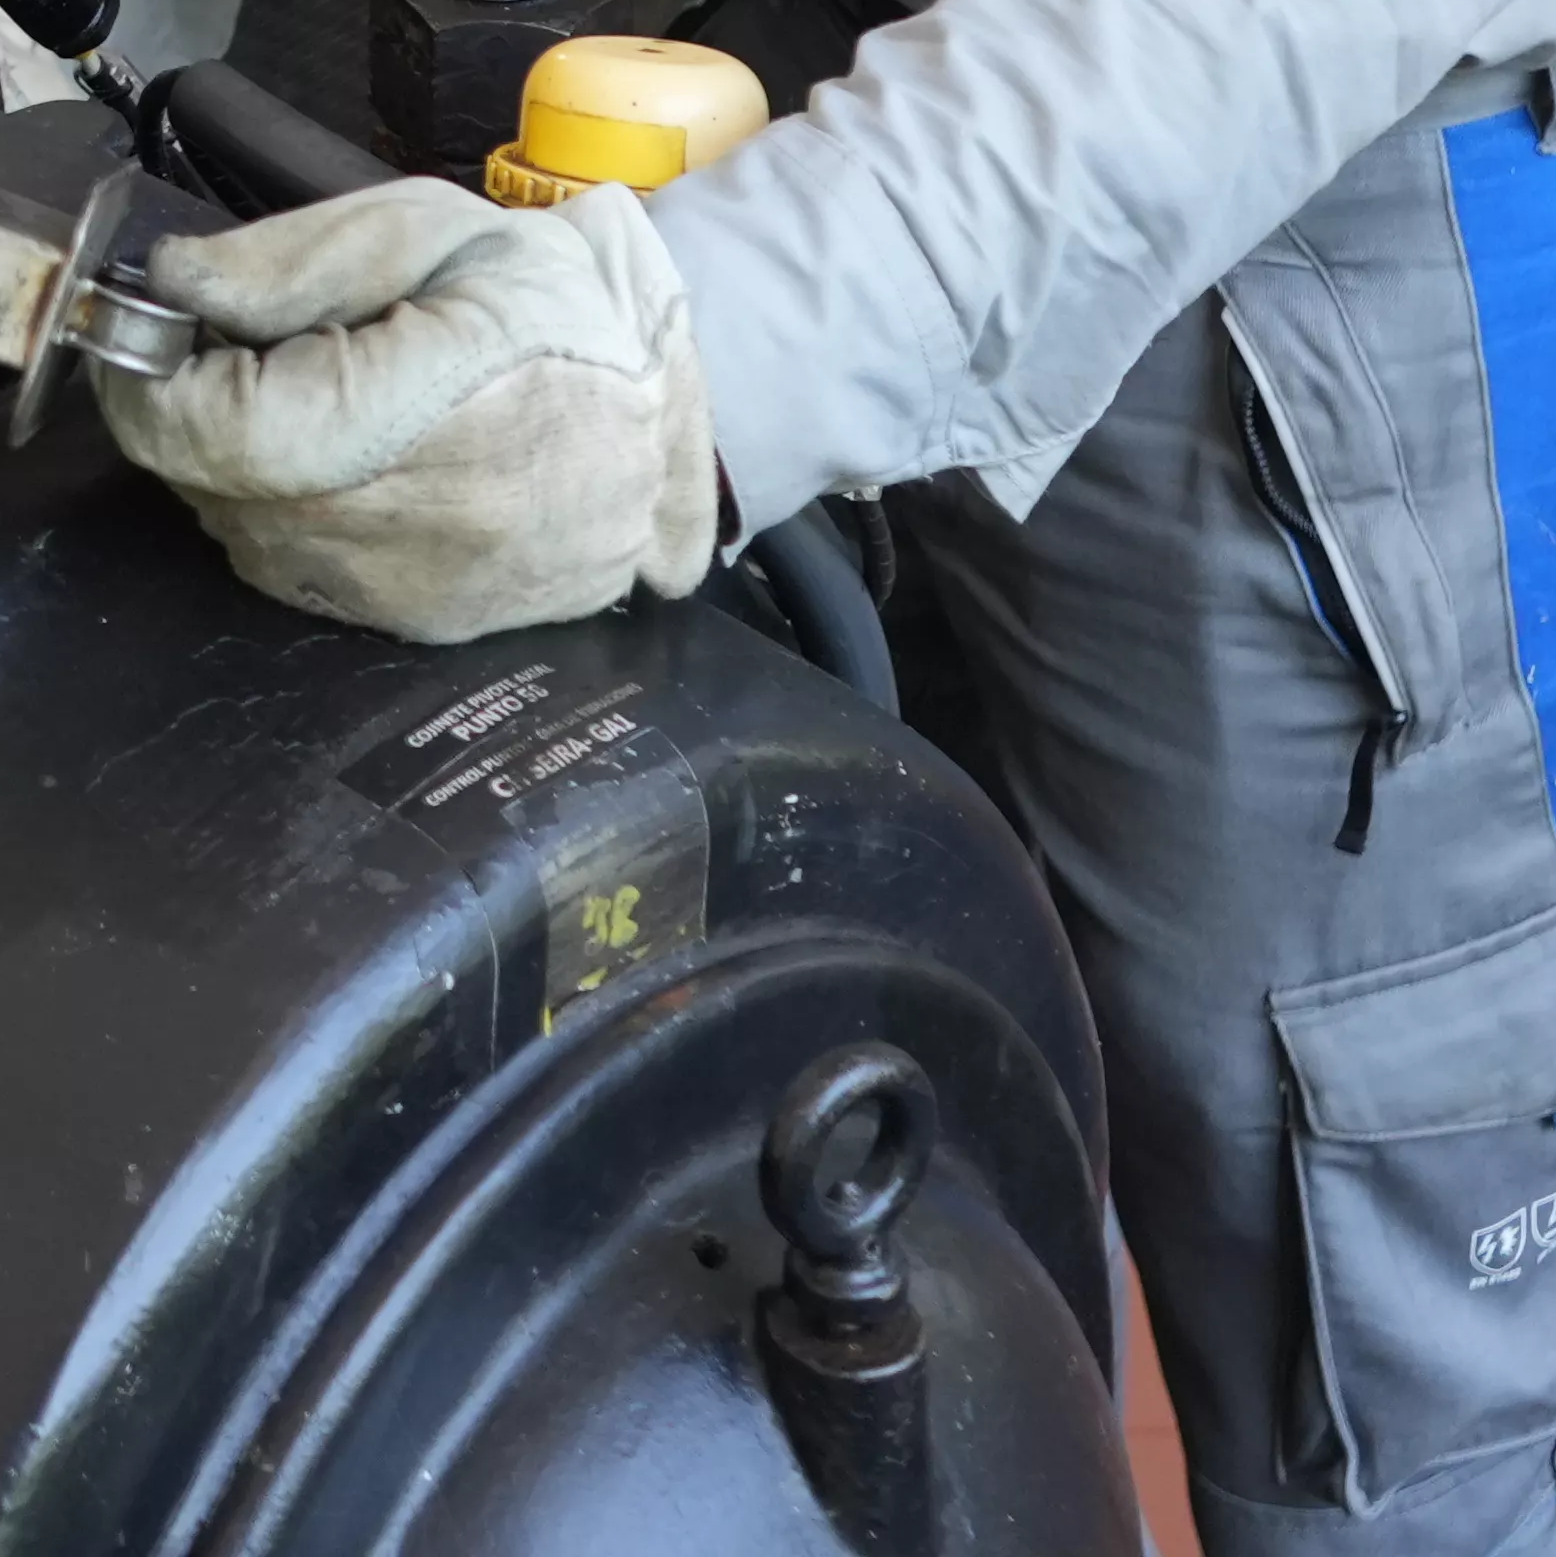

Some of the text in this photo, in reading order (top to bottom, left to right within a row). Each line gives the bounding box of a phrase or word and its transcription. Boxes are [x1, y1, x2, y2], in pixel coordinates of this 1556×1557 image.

[406, 662, 557, 748] COJINETE PIVOTE AXIAL
[450, 695, 525, 742] PUNTO
[586, 711, 638, 743] GA1
[423, 760, 488, 807] CONTROL
